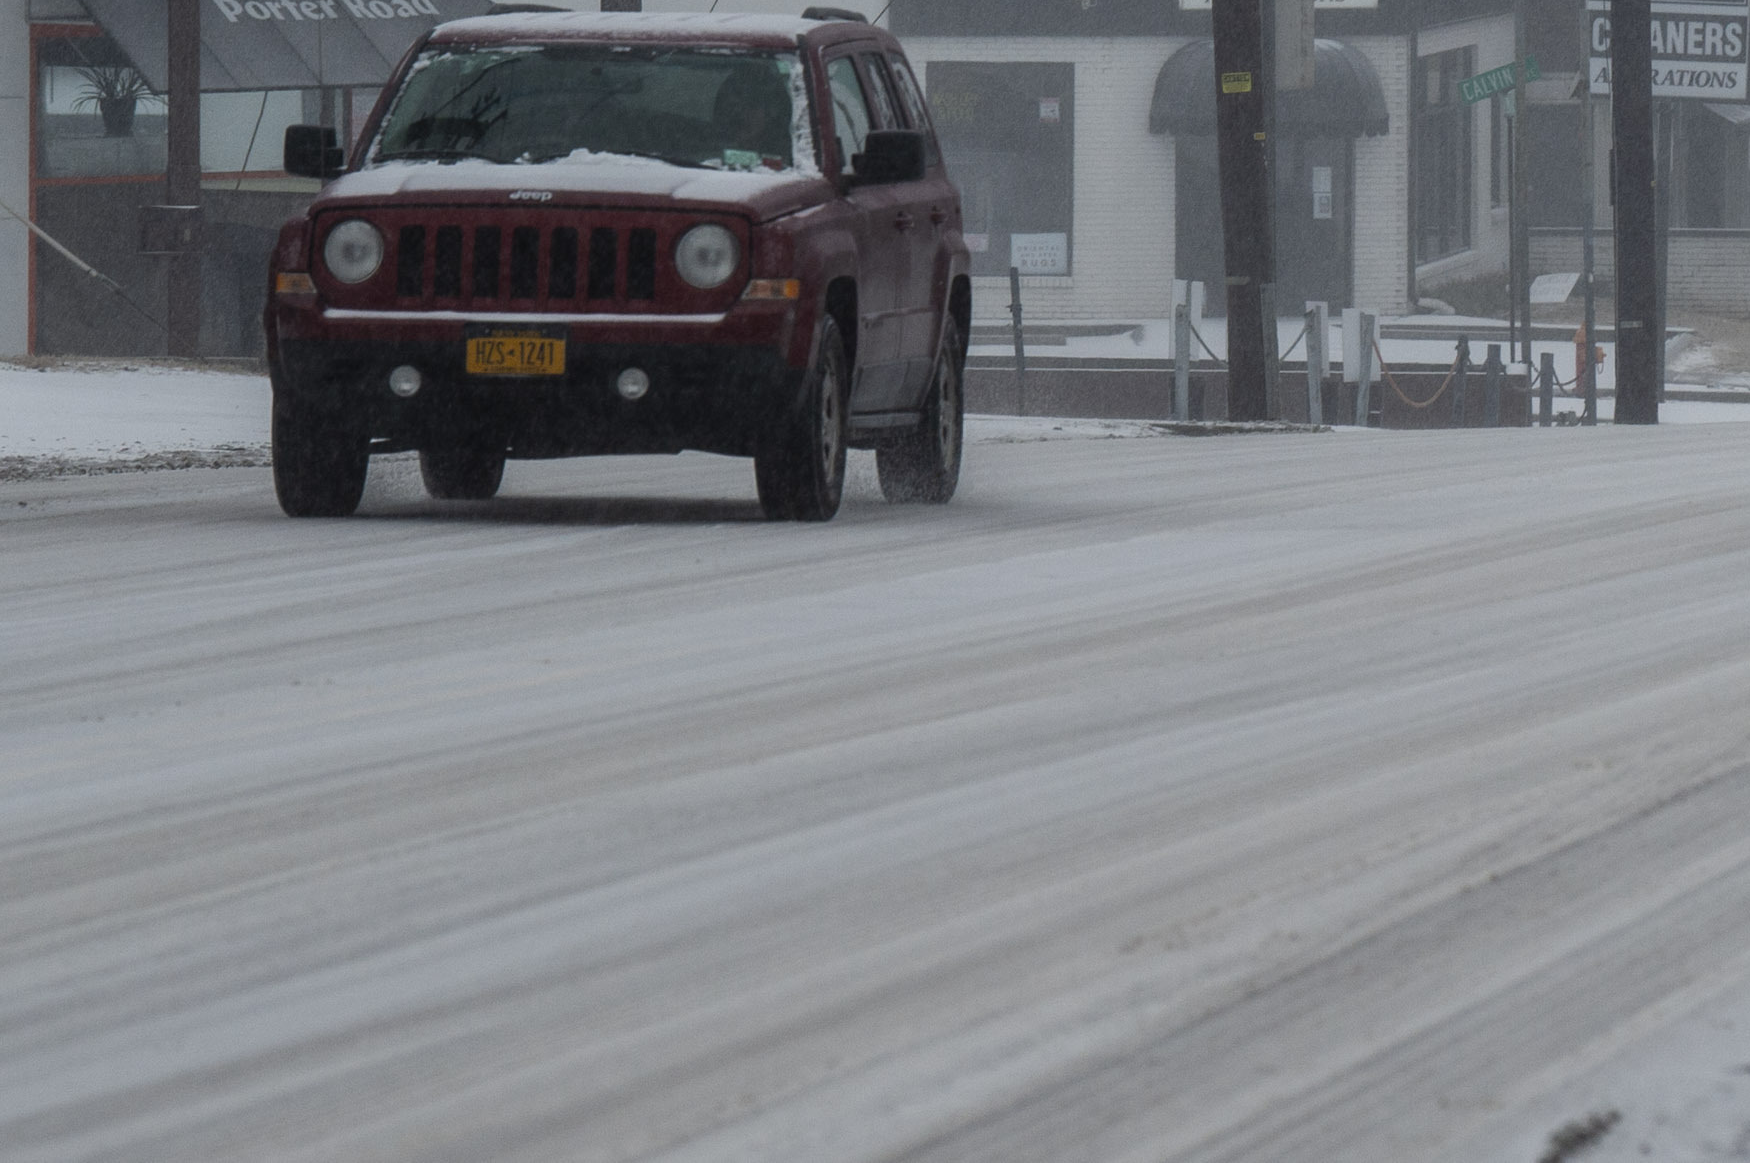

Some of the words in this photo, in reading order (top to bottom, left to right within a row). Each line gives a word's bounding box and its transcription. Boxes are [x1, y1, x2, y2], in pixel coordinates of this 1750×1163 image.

[1592, 17, 1742, 57] CANERS
[1462, 68, 1514, 101] CALVIN
[1595, 67, 1738, 89] ARATIONS
[509, 189, 552, 202] Jeep
[475, 341, 505, 364] HZS
[519, 341, 555, 366] 1241
